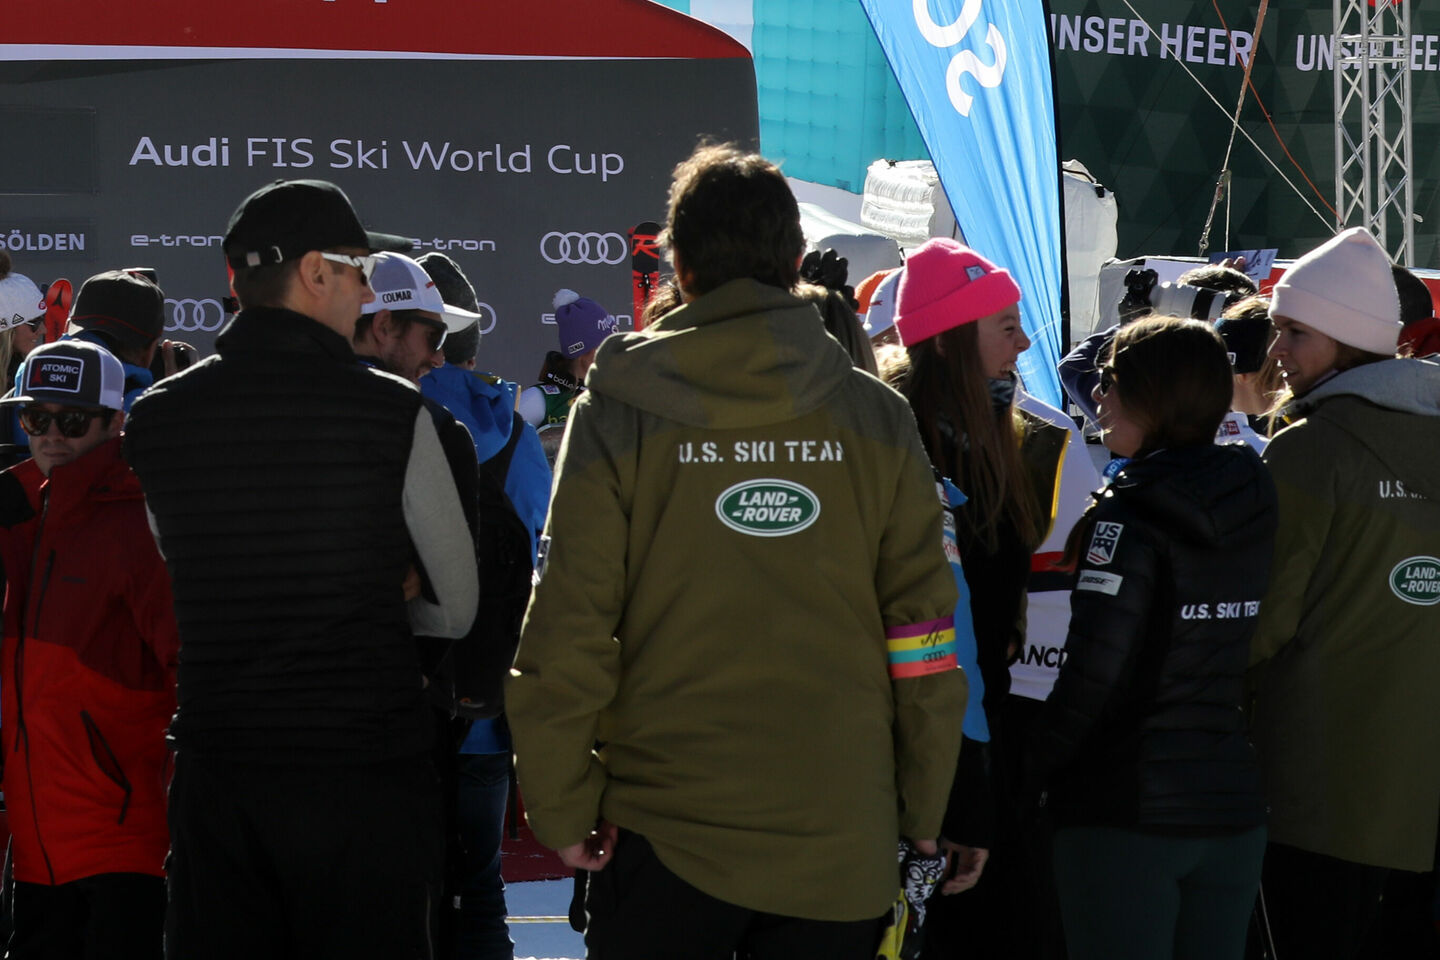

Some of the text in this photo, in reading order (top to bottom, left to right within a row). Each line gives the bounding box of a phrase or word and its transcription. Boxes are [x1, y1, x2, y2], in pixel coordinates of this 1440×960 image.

[1160, 22, 1256, 68] HEER
[129, 136, 625, 182] Audi FIS Ski World Cup
[131, 234, 224, 247] e-tron
[382, 291, 412, 304] COLMAR
[41, 363, 80, 375] ATOMIC
[49, 374, 68, 383] SKI
[679, 441, 724, 464] U.S.
[734, 441, 775, 462] SKI
[1096, 522, 1120, 539] US
[1181, 604, 1211, 619] U.S.
[1216, 603, 1241, 618] SKI
